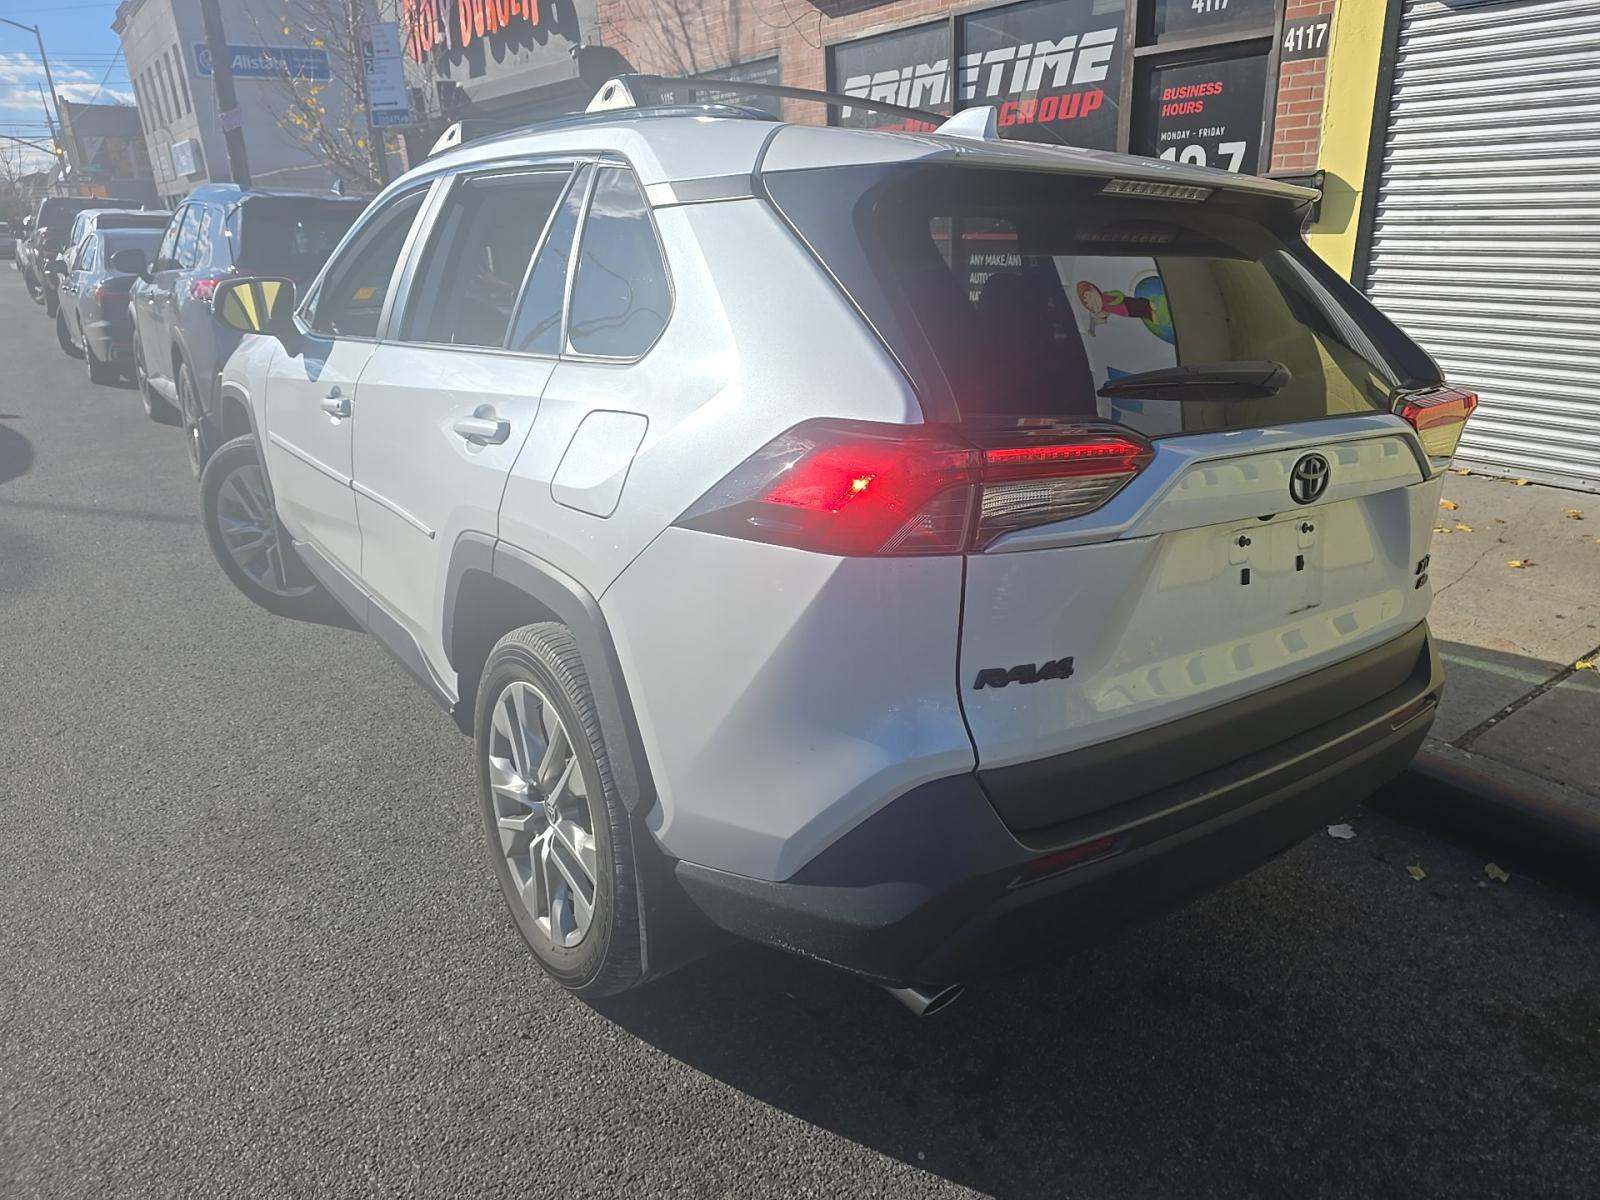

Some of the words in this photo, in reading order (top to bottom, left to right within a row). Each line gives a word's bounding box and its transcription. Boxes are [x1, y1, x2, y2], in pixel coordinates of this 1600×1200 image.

[1283, 23, 1328, 52] 4117
[841, 27, 1118, 118] PRIMETIME
[1163, 81, 1223, 100] BUSINESS
[1000, 89, 1104, 126] GROUP
[1162, 101, 1203, 116] HOURS
[1160, 130, 1191, 141] MONDAY
[1198, 126, 1226, 137] FRIDAY
[969, 254, 984, 266] ANY
